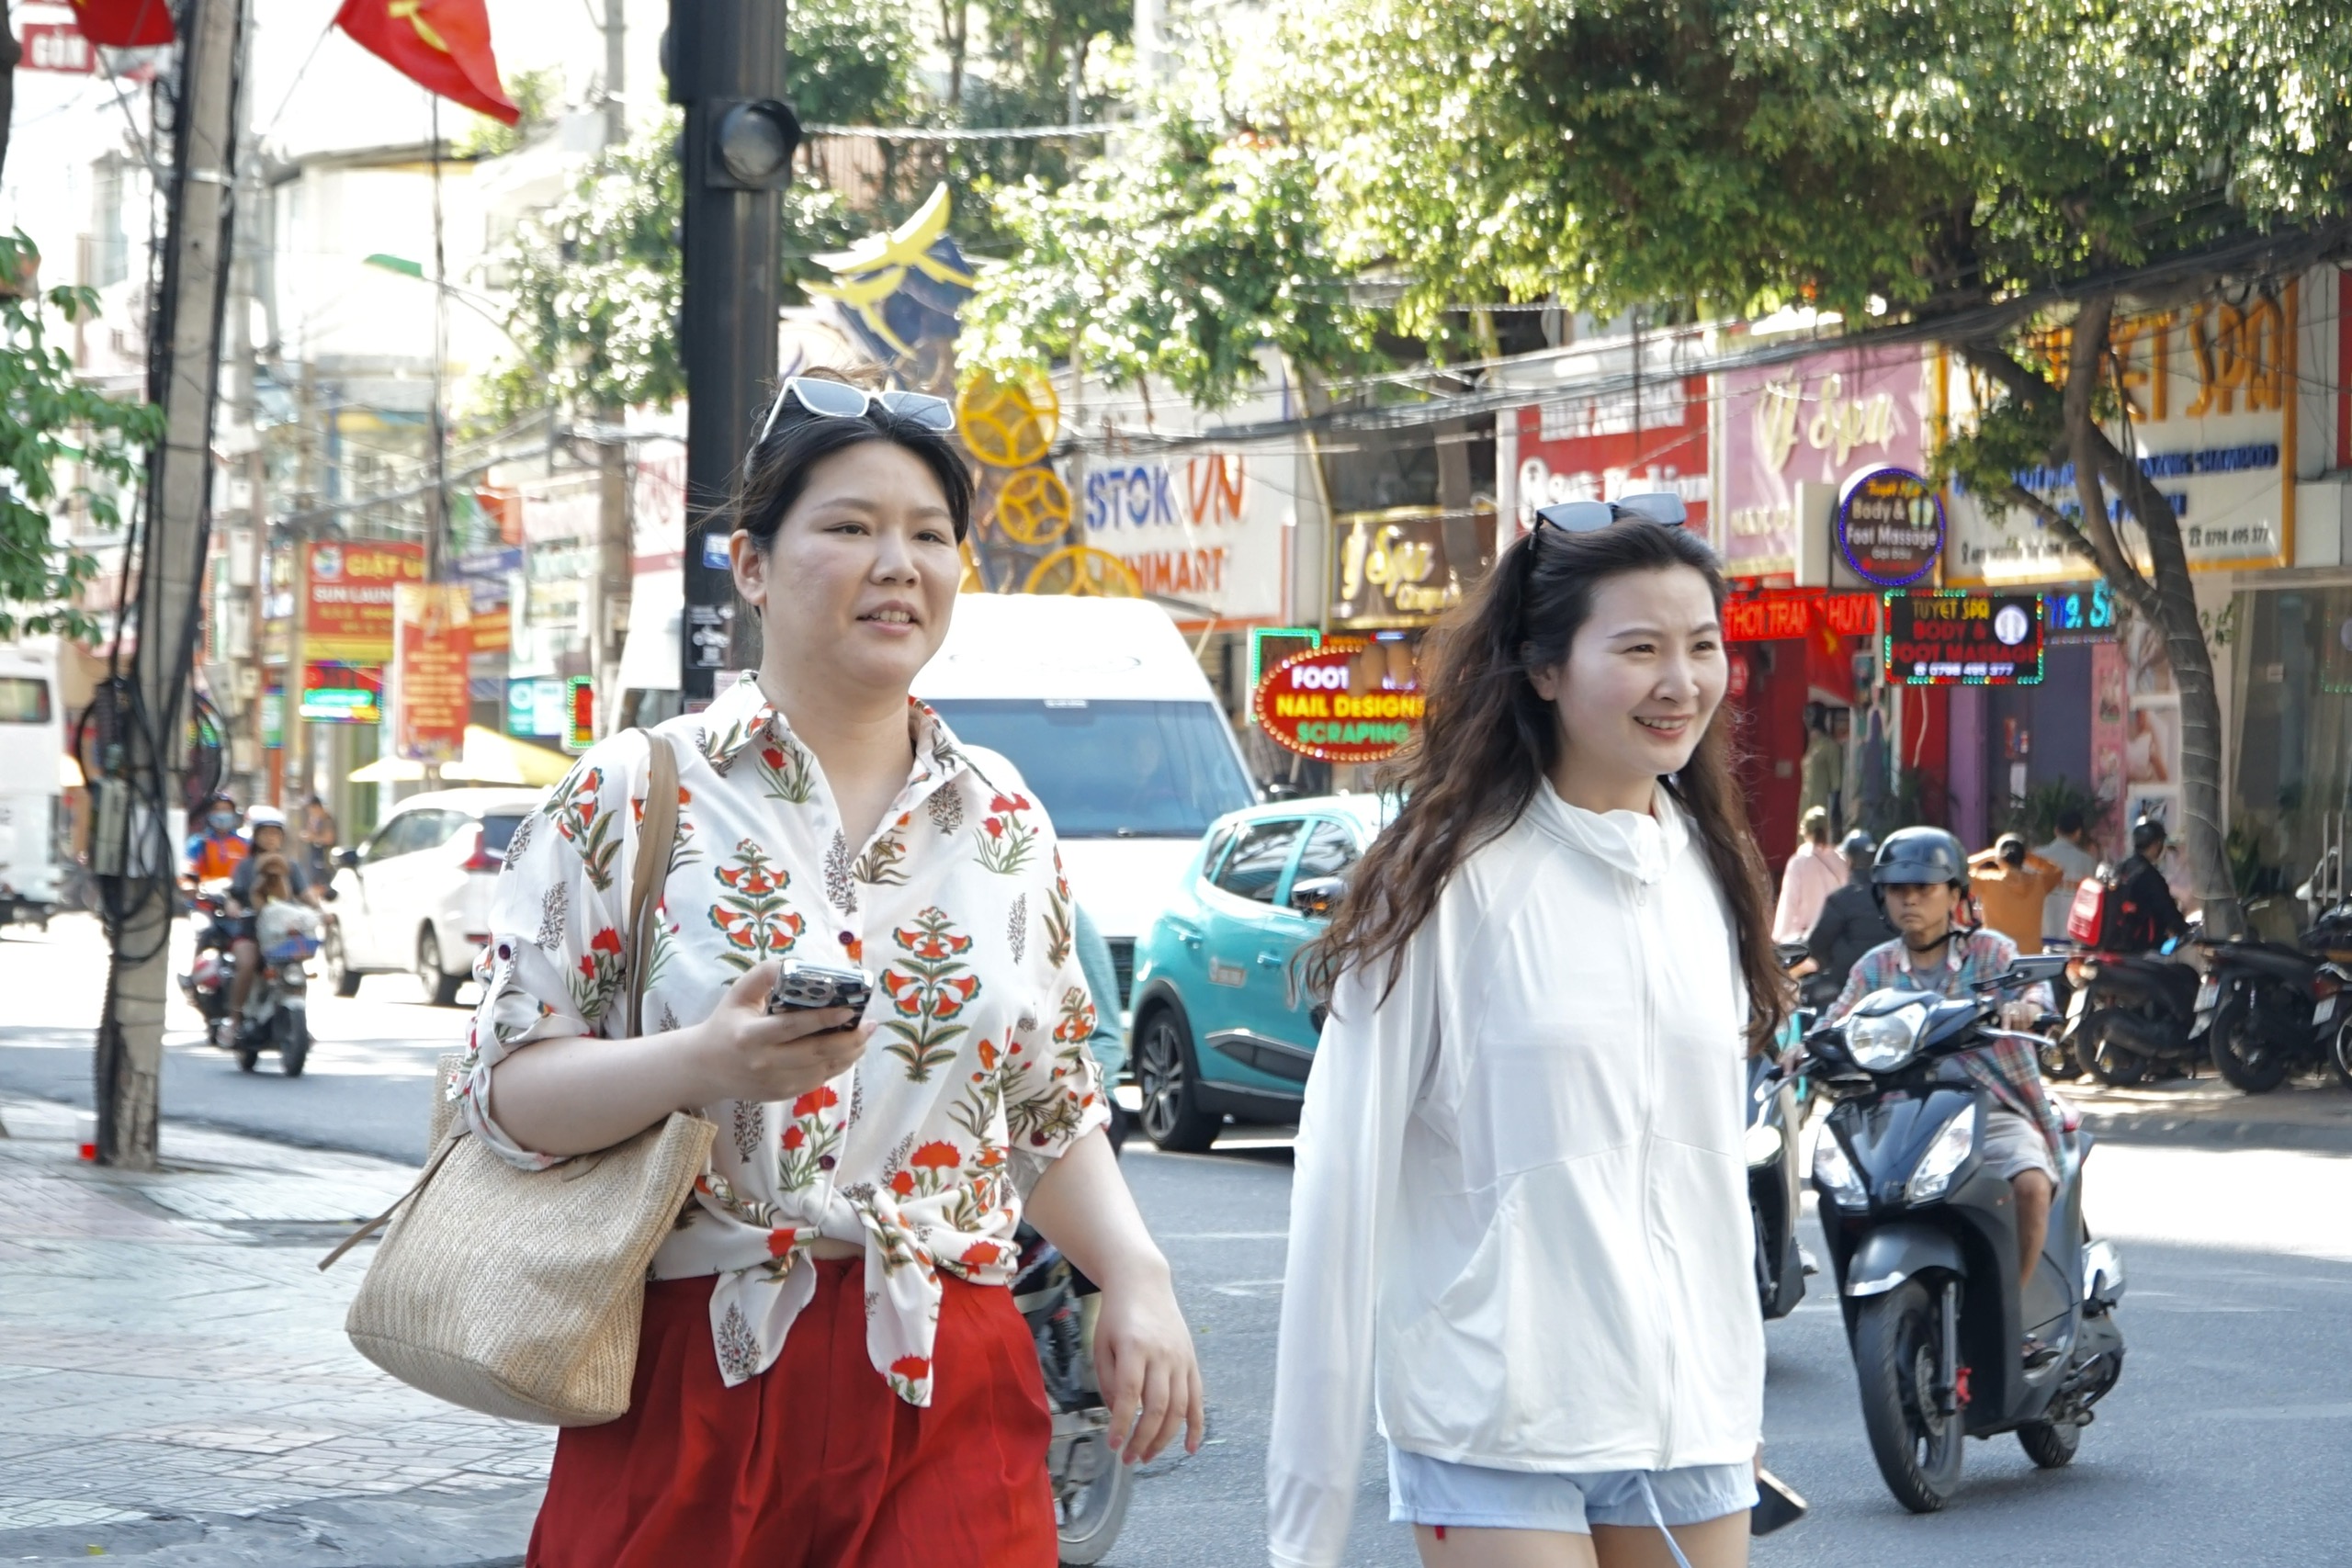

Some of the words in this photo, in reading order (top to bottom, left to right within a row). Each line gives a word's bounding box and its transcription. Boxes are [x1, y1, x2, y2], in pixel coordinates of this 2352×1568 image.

[1086, 466, 1172, 531] STOK
[1852, 497, 1891, 523] Body
[1893, 497, 1905, 520] &
[1845, 523, 1875, 545] Foot
[1877, 524, 1938, 550] Massage
[1913, 620, 1967, 641] BODY
[1946, 642, 2038, 663] MASSAGE
[1988, 661, 2015, 677] 377
[1276, 694, 1329, 718] NAIL
[1296, 721, 1411, 745] SCRAPING
